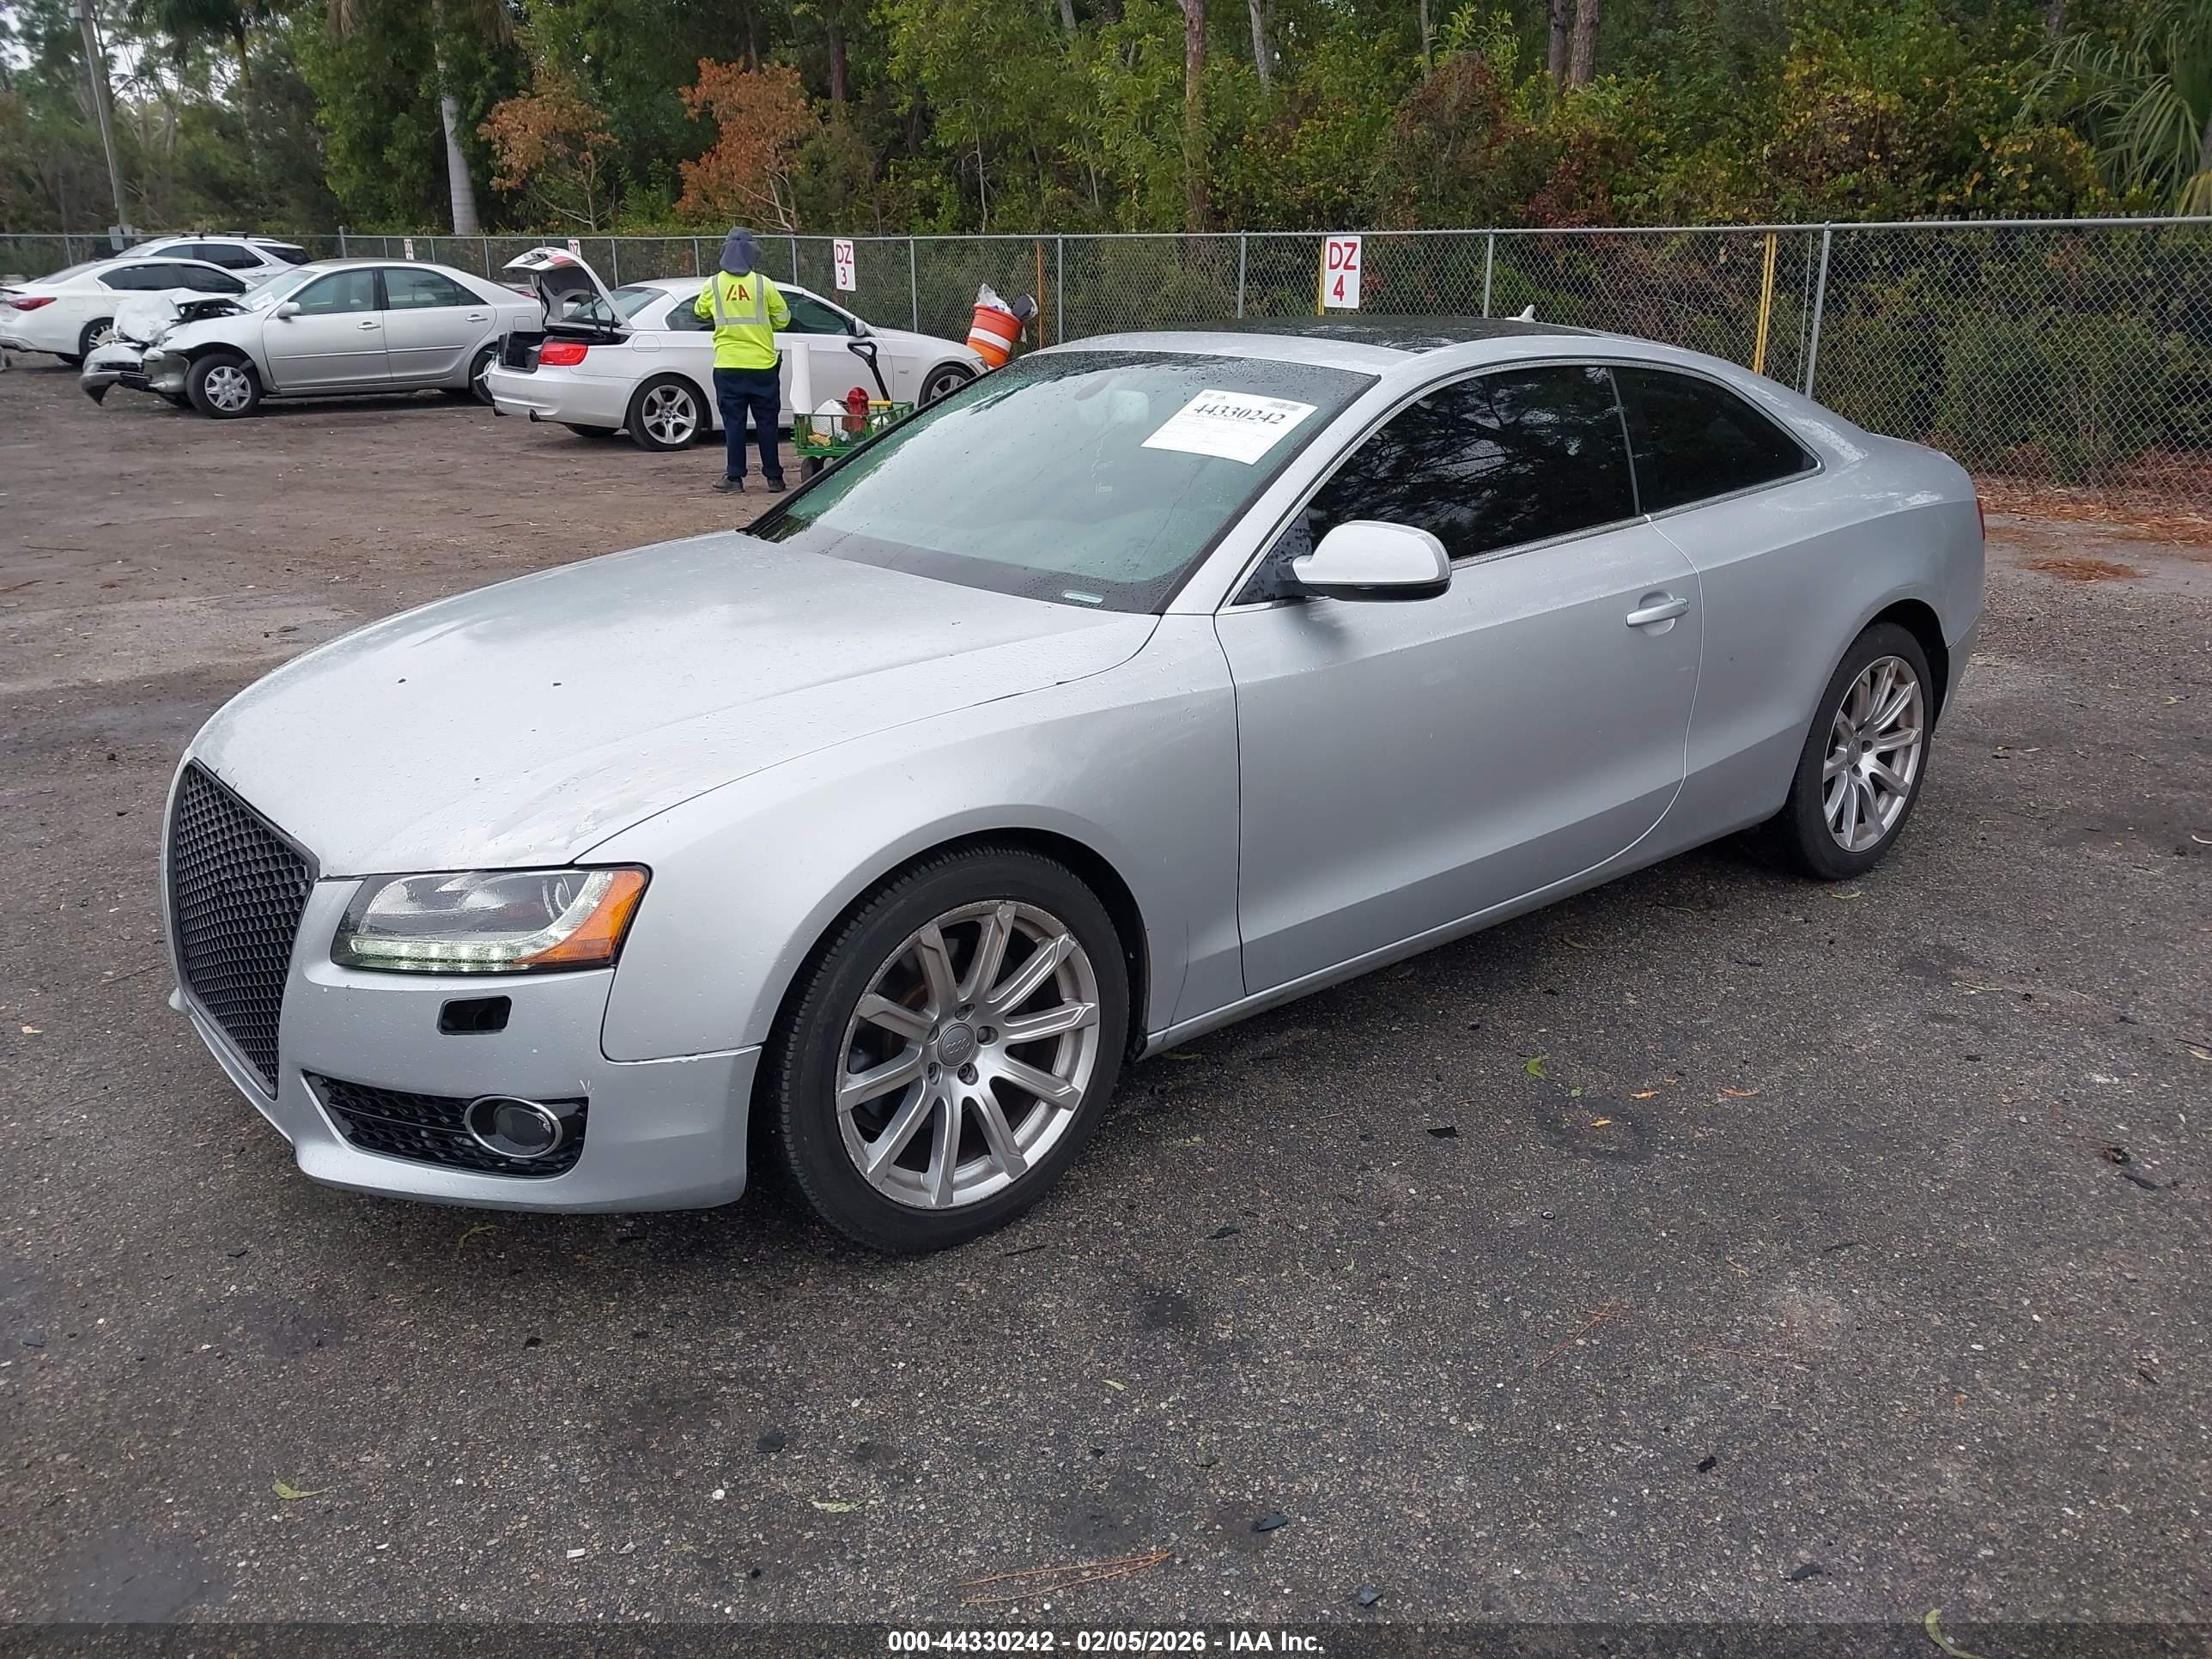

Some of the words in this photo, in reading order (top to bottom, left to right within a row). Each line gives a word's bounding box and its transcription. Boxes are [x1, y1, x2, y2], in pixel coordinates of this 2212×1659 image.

[836, 244, 853, 264] DZ
[1328, 241, 1358, 270] DZ
[841, 266, 848, 285] 3
[1333, 274, 1345, 301] 4
[1194, 403, 1286, 424] 44330242
